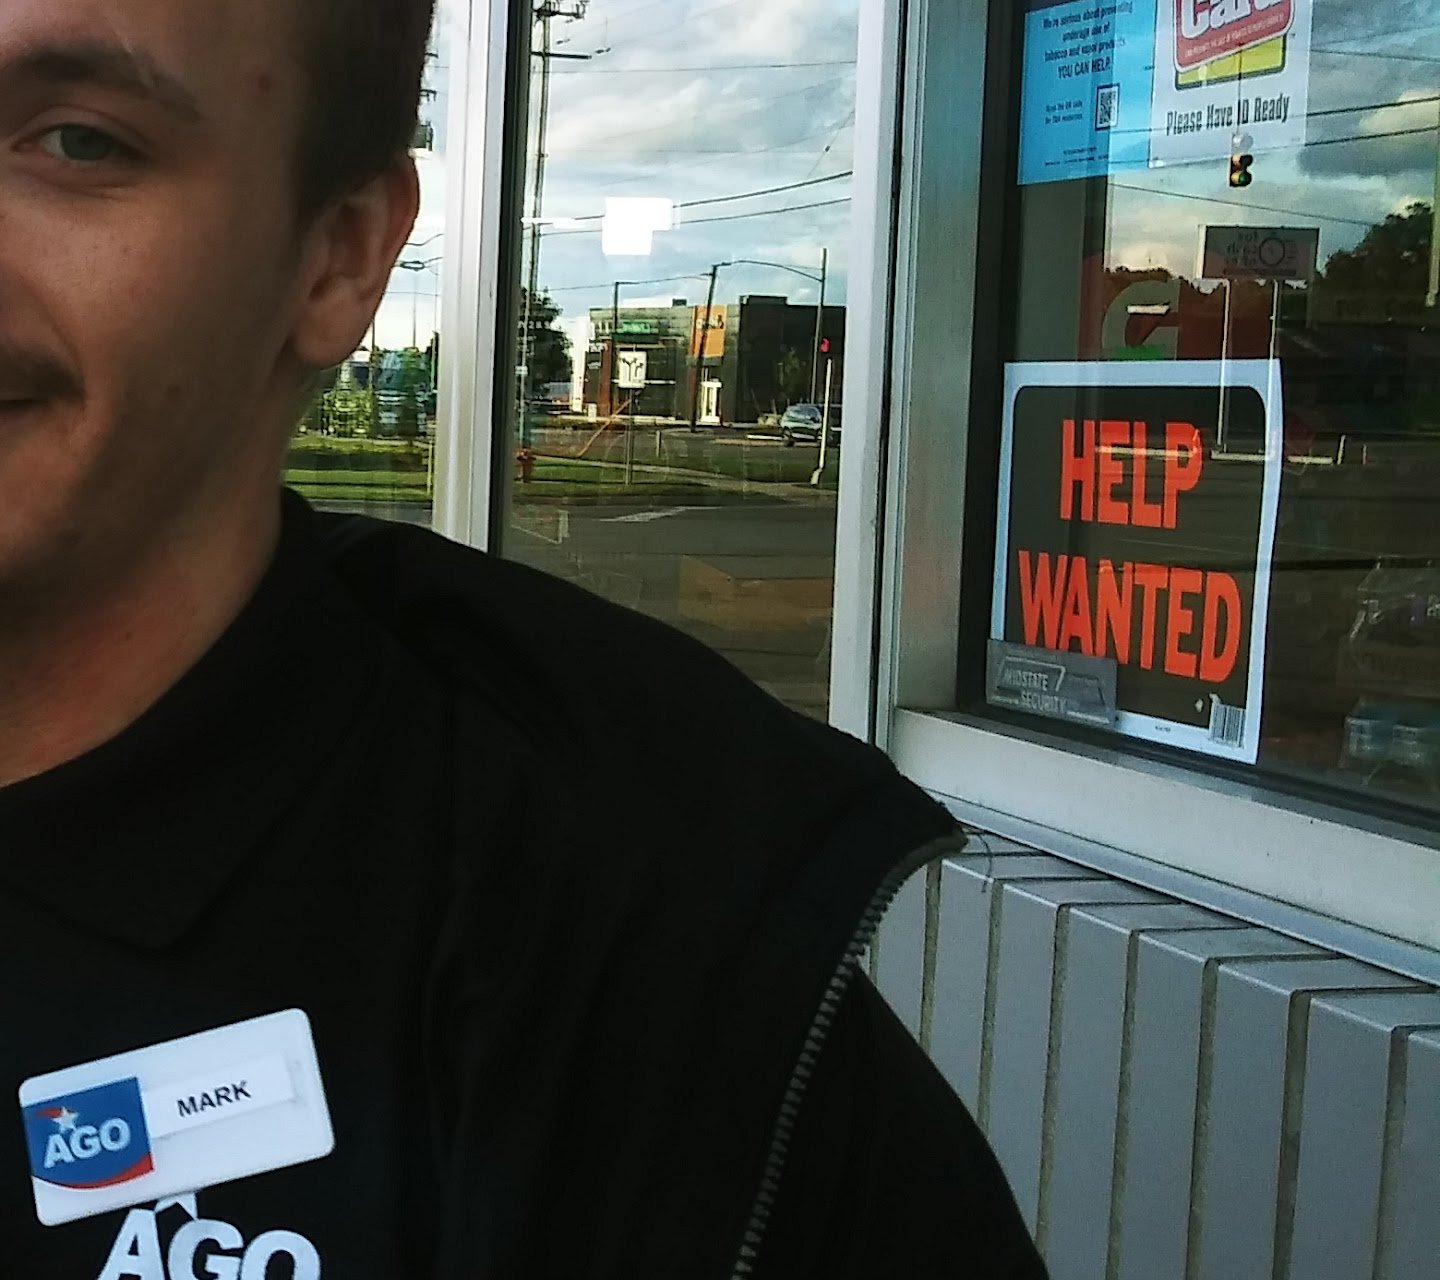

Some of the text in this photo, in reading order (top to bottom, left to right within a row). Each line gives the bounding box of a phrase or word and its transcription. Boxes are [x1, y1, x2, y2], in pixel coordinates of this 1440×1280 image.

[1057, 63, 1074, 80] YOU
[1074, 60, 1090, 77] CAN
[1166, 92, 1290, 136] Please Have ID Ready
[1060, 419, 1203, 530] HELP
[1018, 549, 1242, 684] WANTED
[176, 1080, 252, 1118] MARK
[43, 1118, 131, 1169] AGO
